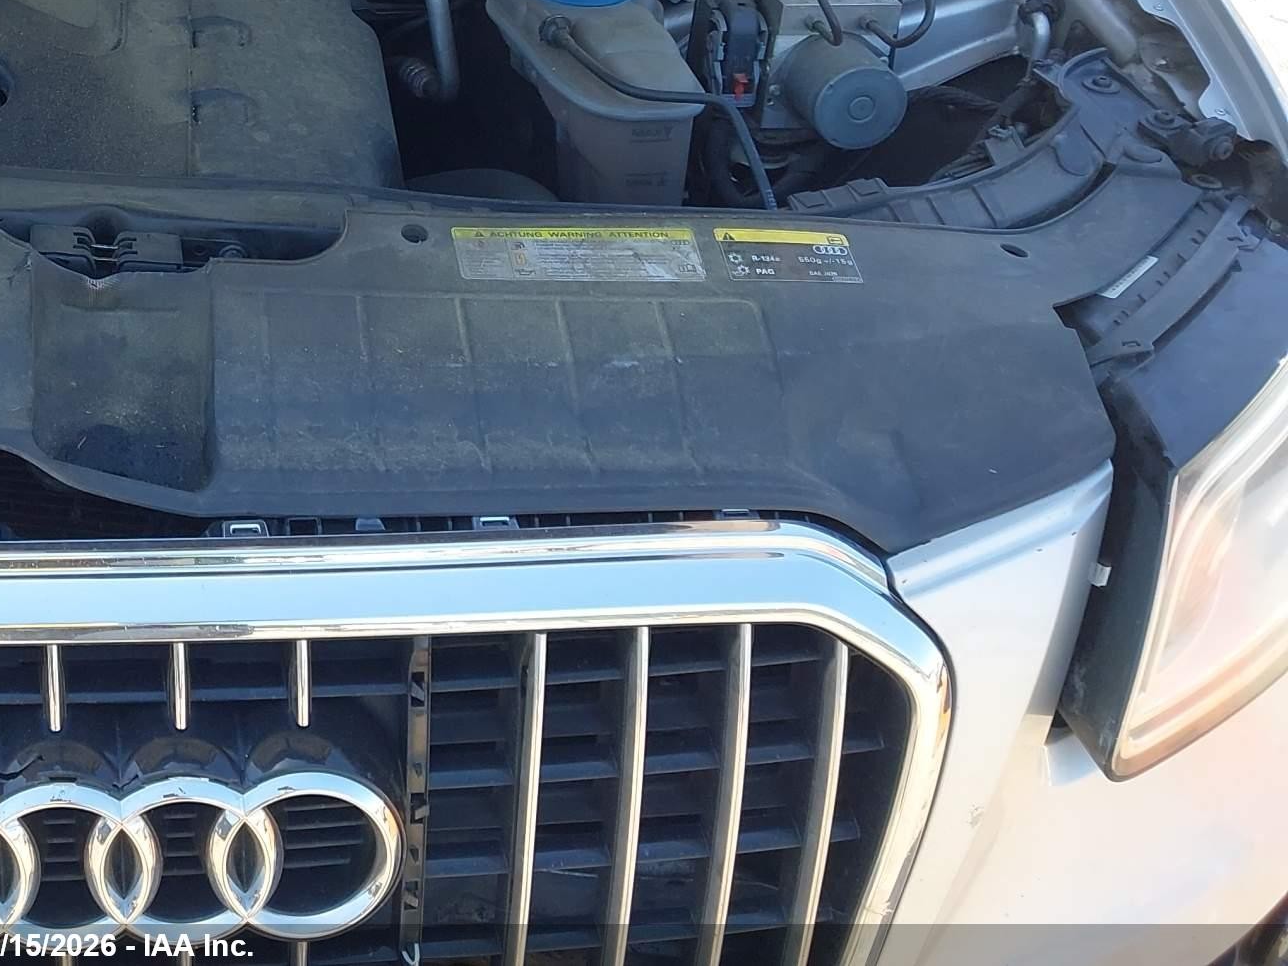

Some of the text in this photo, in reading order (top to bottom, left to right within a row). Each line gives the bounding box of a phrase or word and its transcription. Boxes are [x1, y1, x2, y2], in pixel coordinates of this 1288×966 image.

[490, 230, 669, 238] ACHTUNG WARNING ATTENTION
